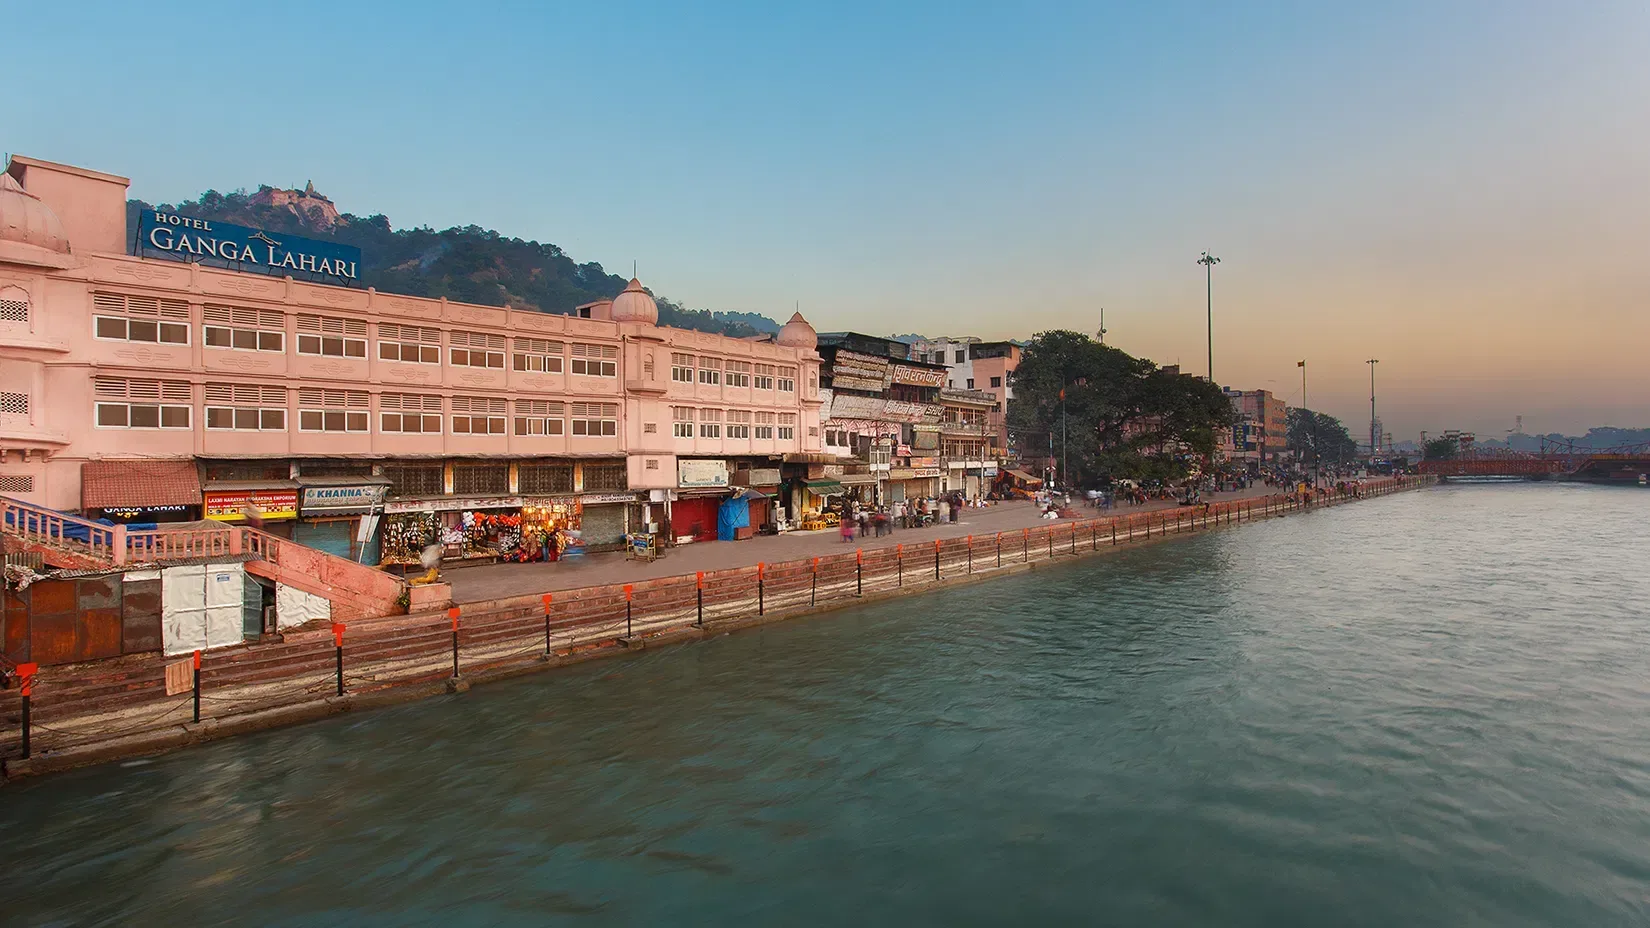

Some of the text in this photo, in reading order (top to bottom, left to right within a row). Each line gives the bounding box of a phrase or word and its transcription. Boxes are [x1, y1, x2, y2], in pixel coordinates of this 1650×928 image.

[156, 213, 212, 231] HOTEL
[150, 227, 357, 279] GANGA LAHARI
